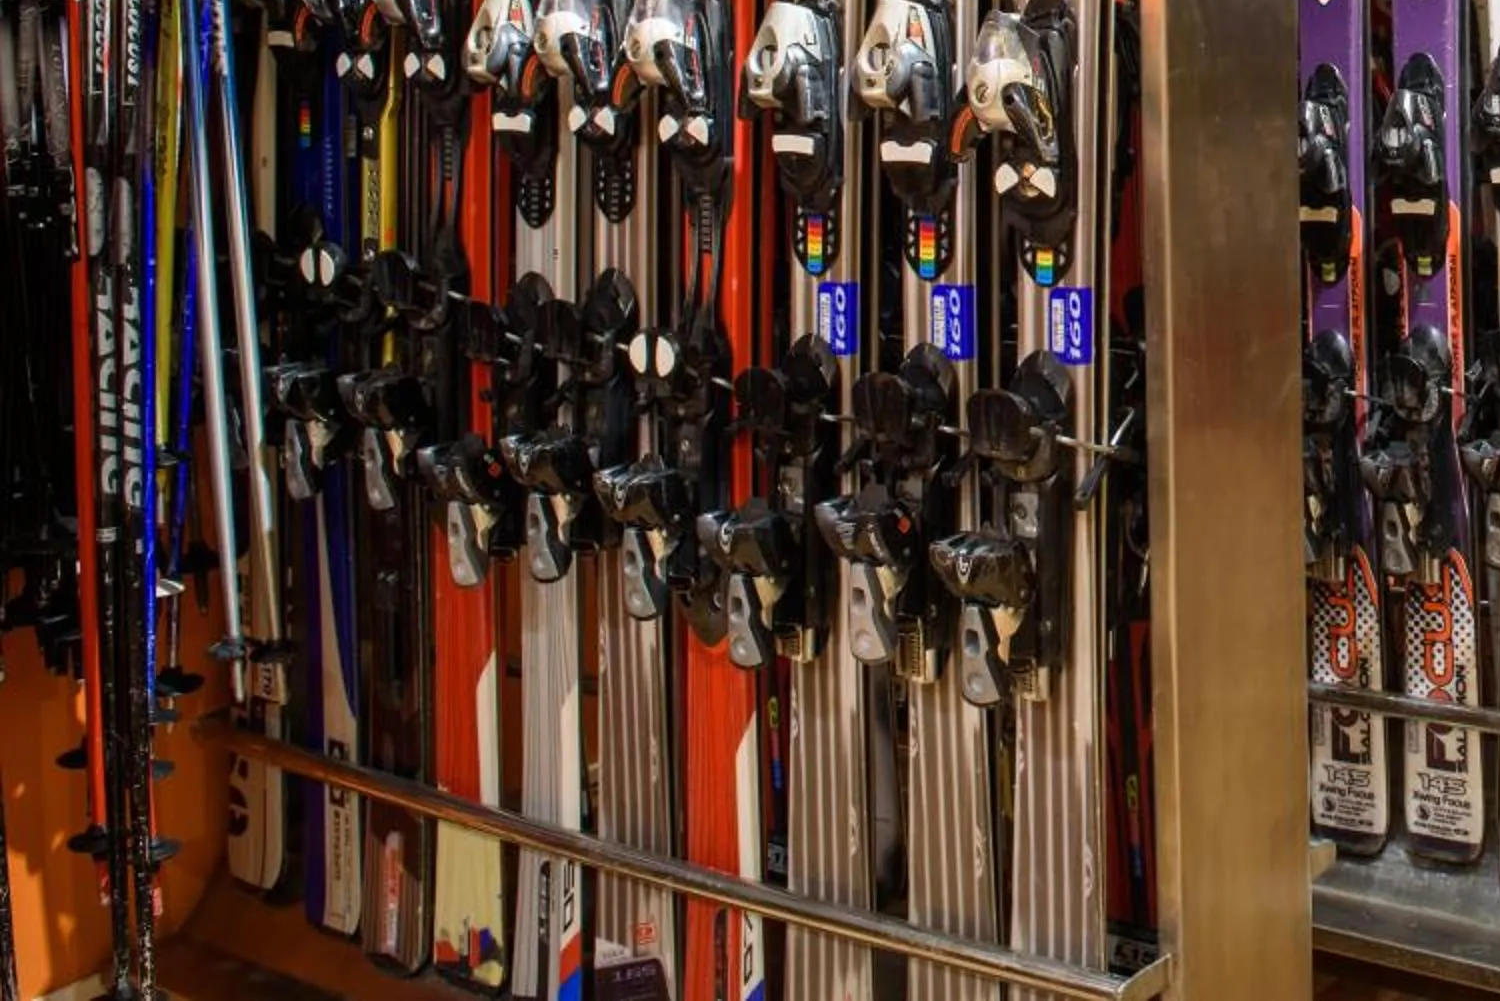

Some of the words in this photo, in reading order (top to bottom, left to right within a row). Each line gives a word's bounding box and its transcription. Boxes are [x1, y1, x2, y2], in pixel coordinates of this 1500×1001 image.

[834, 288, 846, 349] 160
[949, 290, 960, 355] 160
[1069, 292, 1081, 359] 160
[1323, 765, 1371, 787] 145
[1418, 772, 1467, 795] 145
